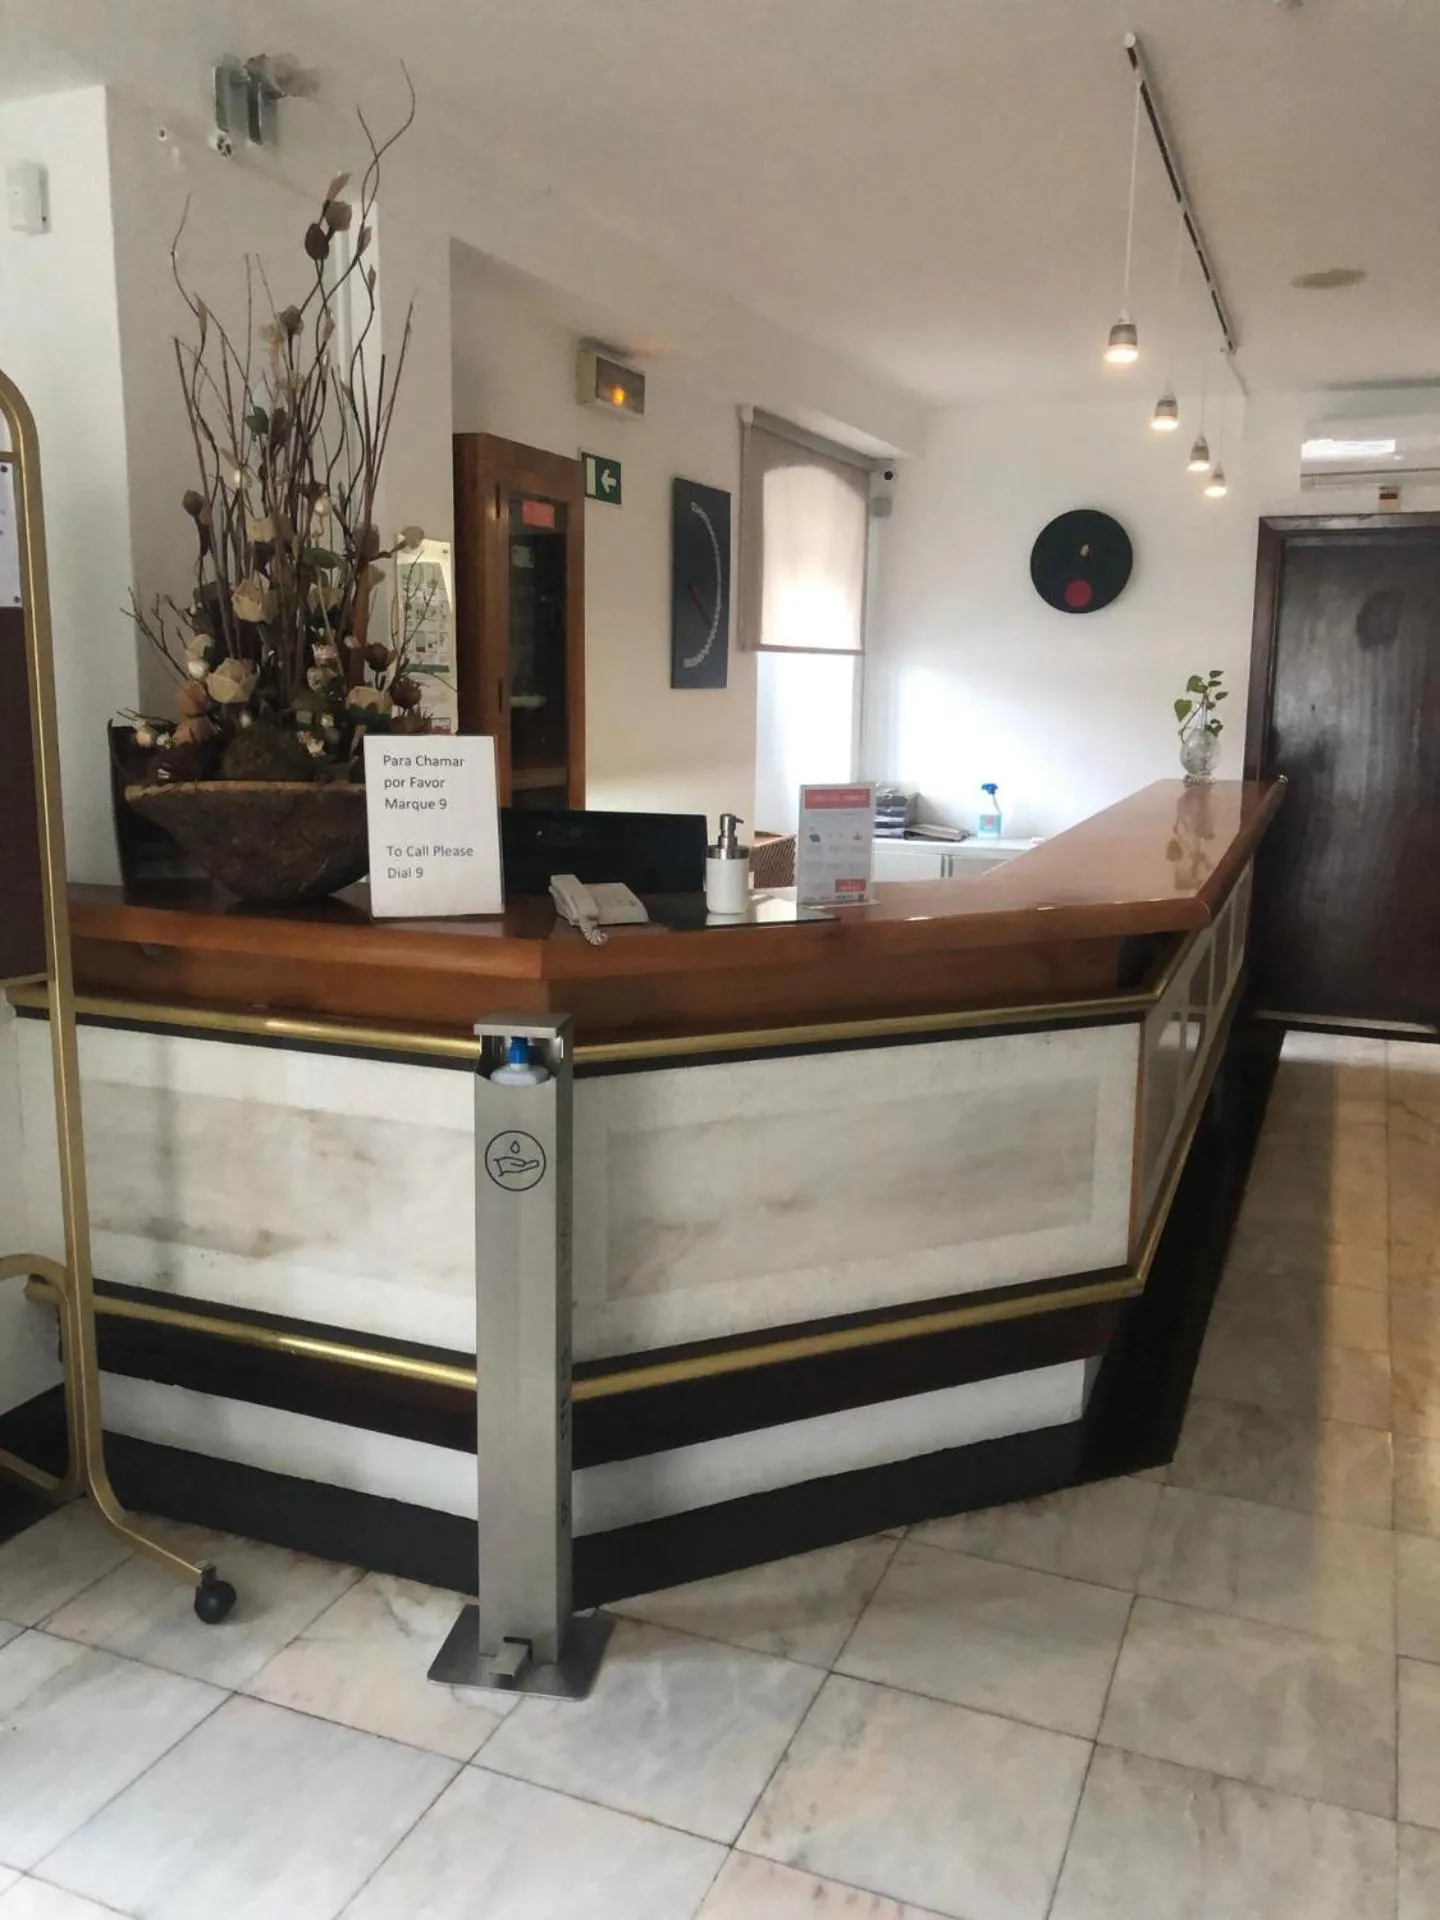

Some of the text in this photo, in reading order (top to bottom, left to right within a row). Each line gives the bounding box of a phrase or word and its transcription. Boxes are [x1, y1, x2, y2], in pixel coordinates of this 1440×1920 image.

[383, 755, 465, 768] Para Chamar
[384, 777, 446, 791] por Favor
[384, 798, 448, 812] Marque 9
[386, 845, 475, 857] To Call Please
[387, 867, 424, 879] Dial 9
